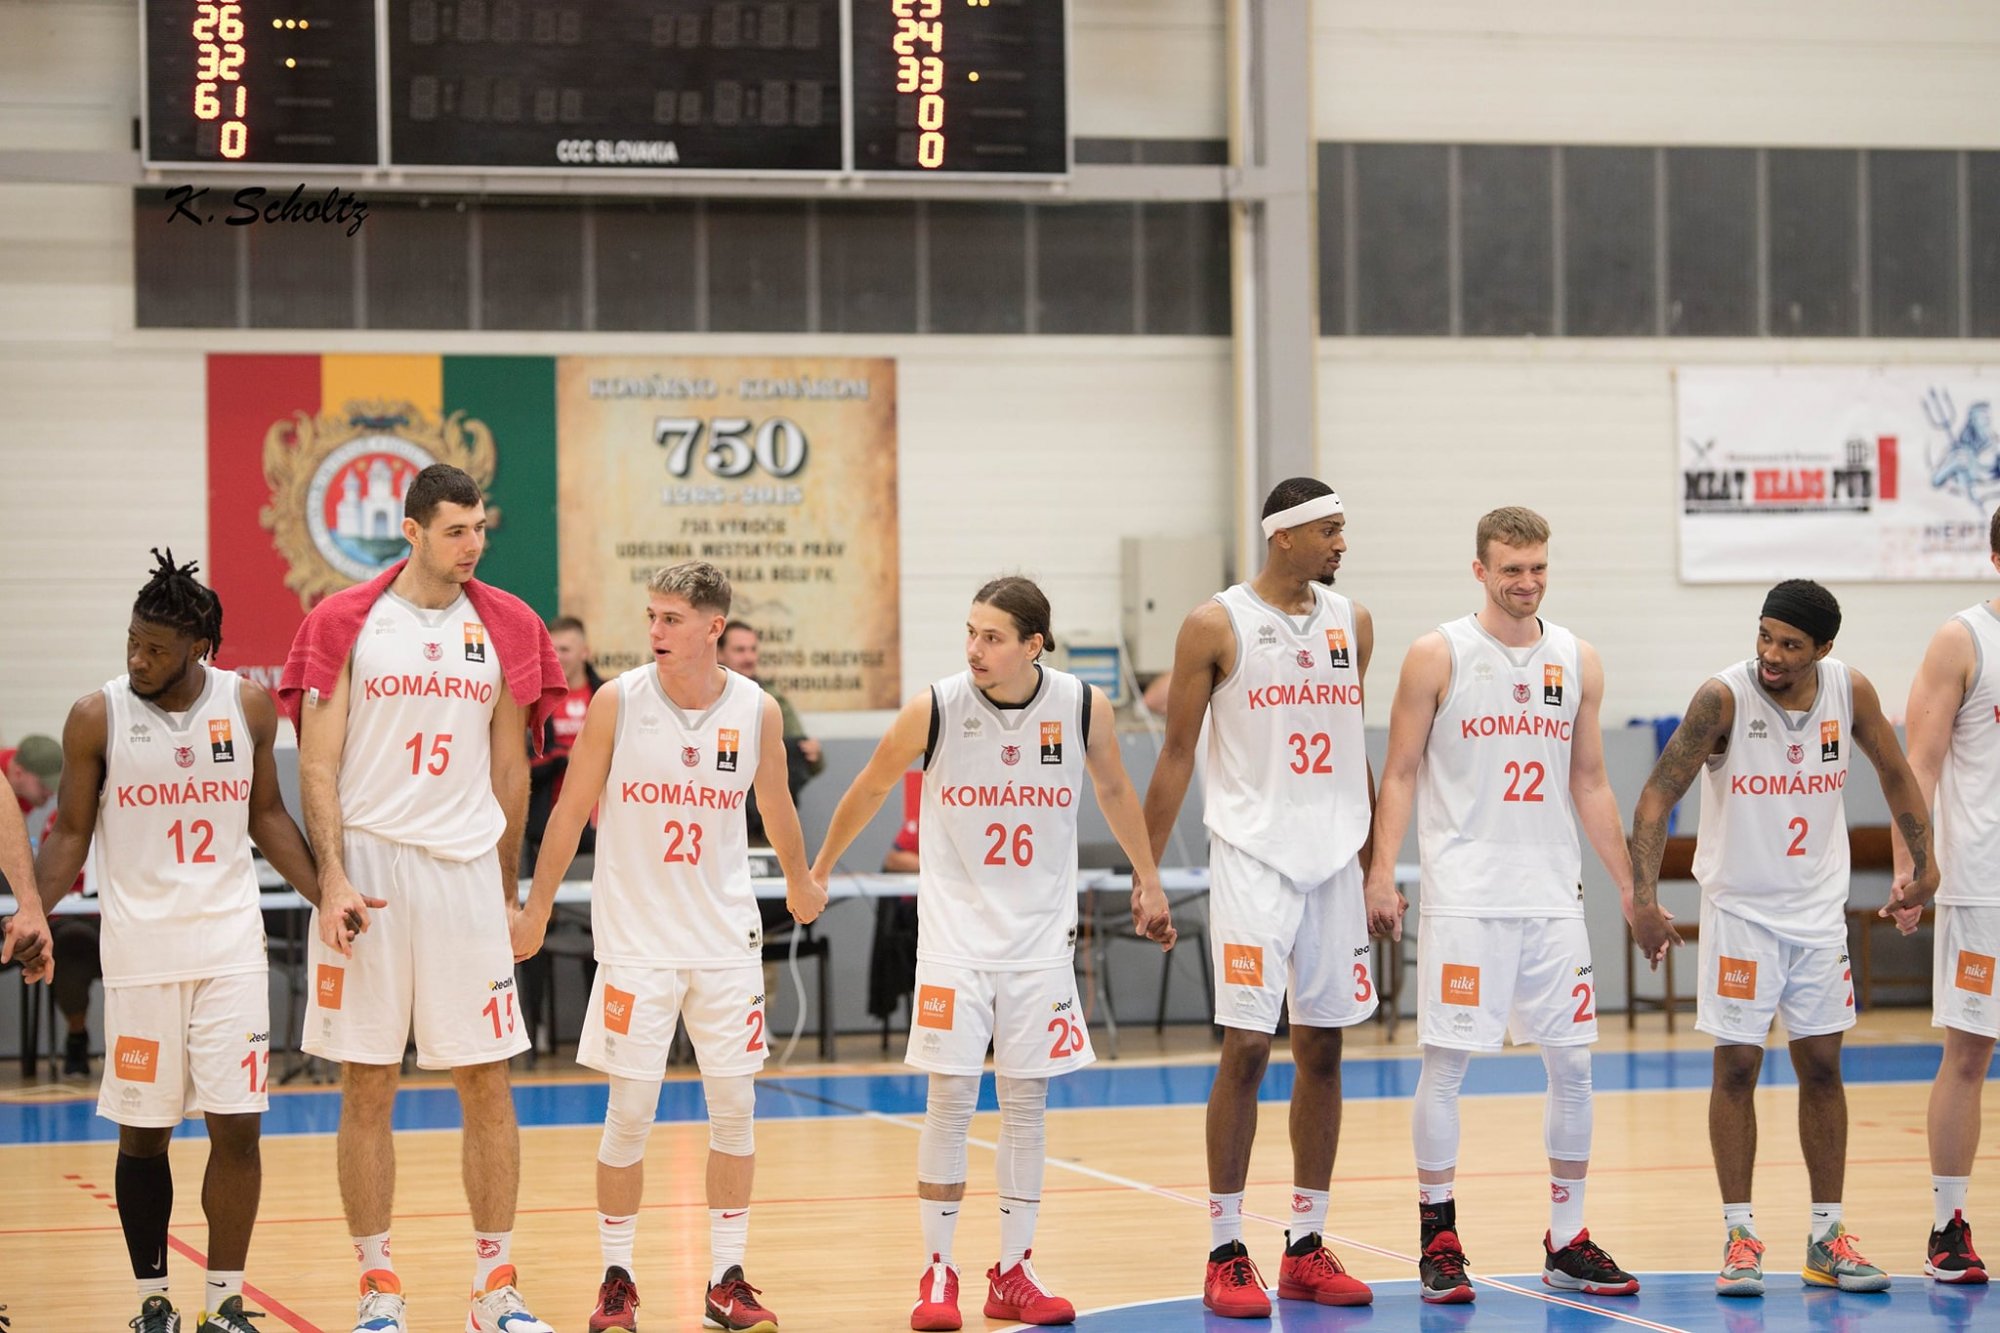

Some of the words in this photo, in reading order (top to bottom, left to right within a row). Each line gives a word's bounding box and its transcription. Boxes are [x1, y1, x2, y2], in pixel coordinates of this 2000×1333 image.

[193, 4, 244, 41] 26
[893, 19, 943, 55] 24
[196, 43, 246, 80] 32
[897, 56, 944, 93] 33
[194, 82, 247, 119] 61
[917, 94, 945, 131] 0
[220, 121, 247, 158] 0
[556, 139, 594, 163] CCC
[595, 139, 680, 164] SLOVAKIA
[917, 131, 945, 168] 0
[655, 416, 809, 479] 750
[364, 671, 493, 704] KOMÁRNO
[1248, 679, 1362, 710] KOMÁRNO
[405, 732, 453, 776] 15
[1288, 732, 1333, 775] 32
[117, 776, 250, 808] KOMÁRNO
[622, 780, 744, 810] KOMÁRNO
[941, 780, 1073, 808] KOMÁRNO
[1503, 760, 1545, 802] 22
[1731, 769, 1848, 795] KOMÁRNO
[167, 819, 216, 864] 12
[664, 820, 703, 866] 23
[984, 822, 1034, 867] 26
[1786, 816, 1809, 857] 2
[1450, 976, 1475, 991] niké
[1724, 969, 1750, 984] niké
[923, 997, 947, 1013] niké
[1571, 982, 1597, 1023] 2
[121, 1049, 149, 1066] niké
